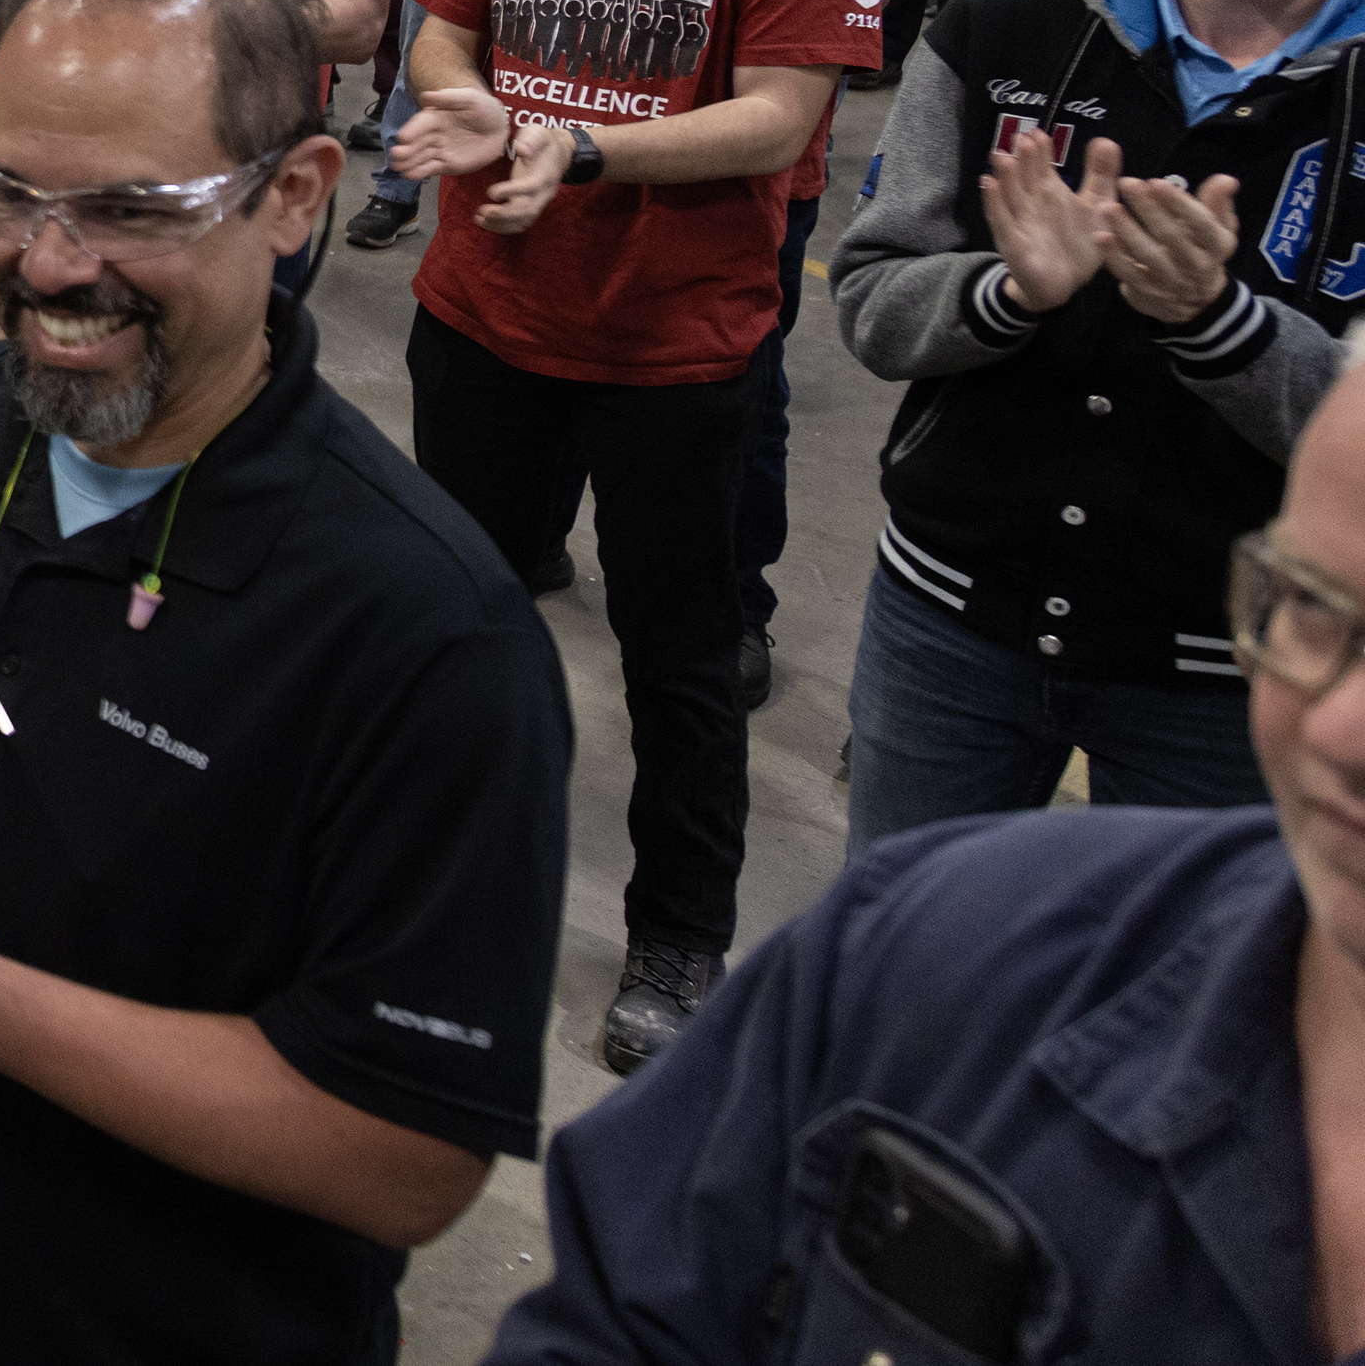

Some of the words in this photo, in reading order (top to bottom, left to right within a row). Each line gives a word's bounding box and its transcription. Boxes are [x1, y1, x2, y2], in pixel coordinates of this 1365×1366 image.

[845, 12, 880, 30] 9114
[494, 68, 669, 119] L'EXCELLENCE
[986, 78, 1107, 120] Canda
[1270, 159, 1323, 258] CANADA
[99, 699, 146, 738] Volvo
[148, 722, 210, 771] Buses
